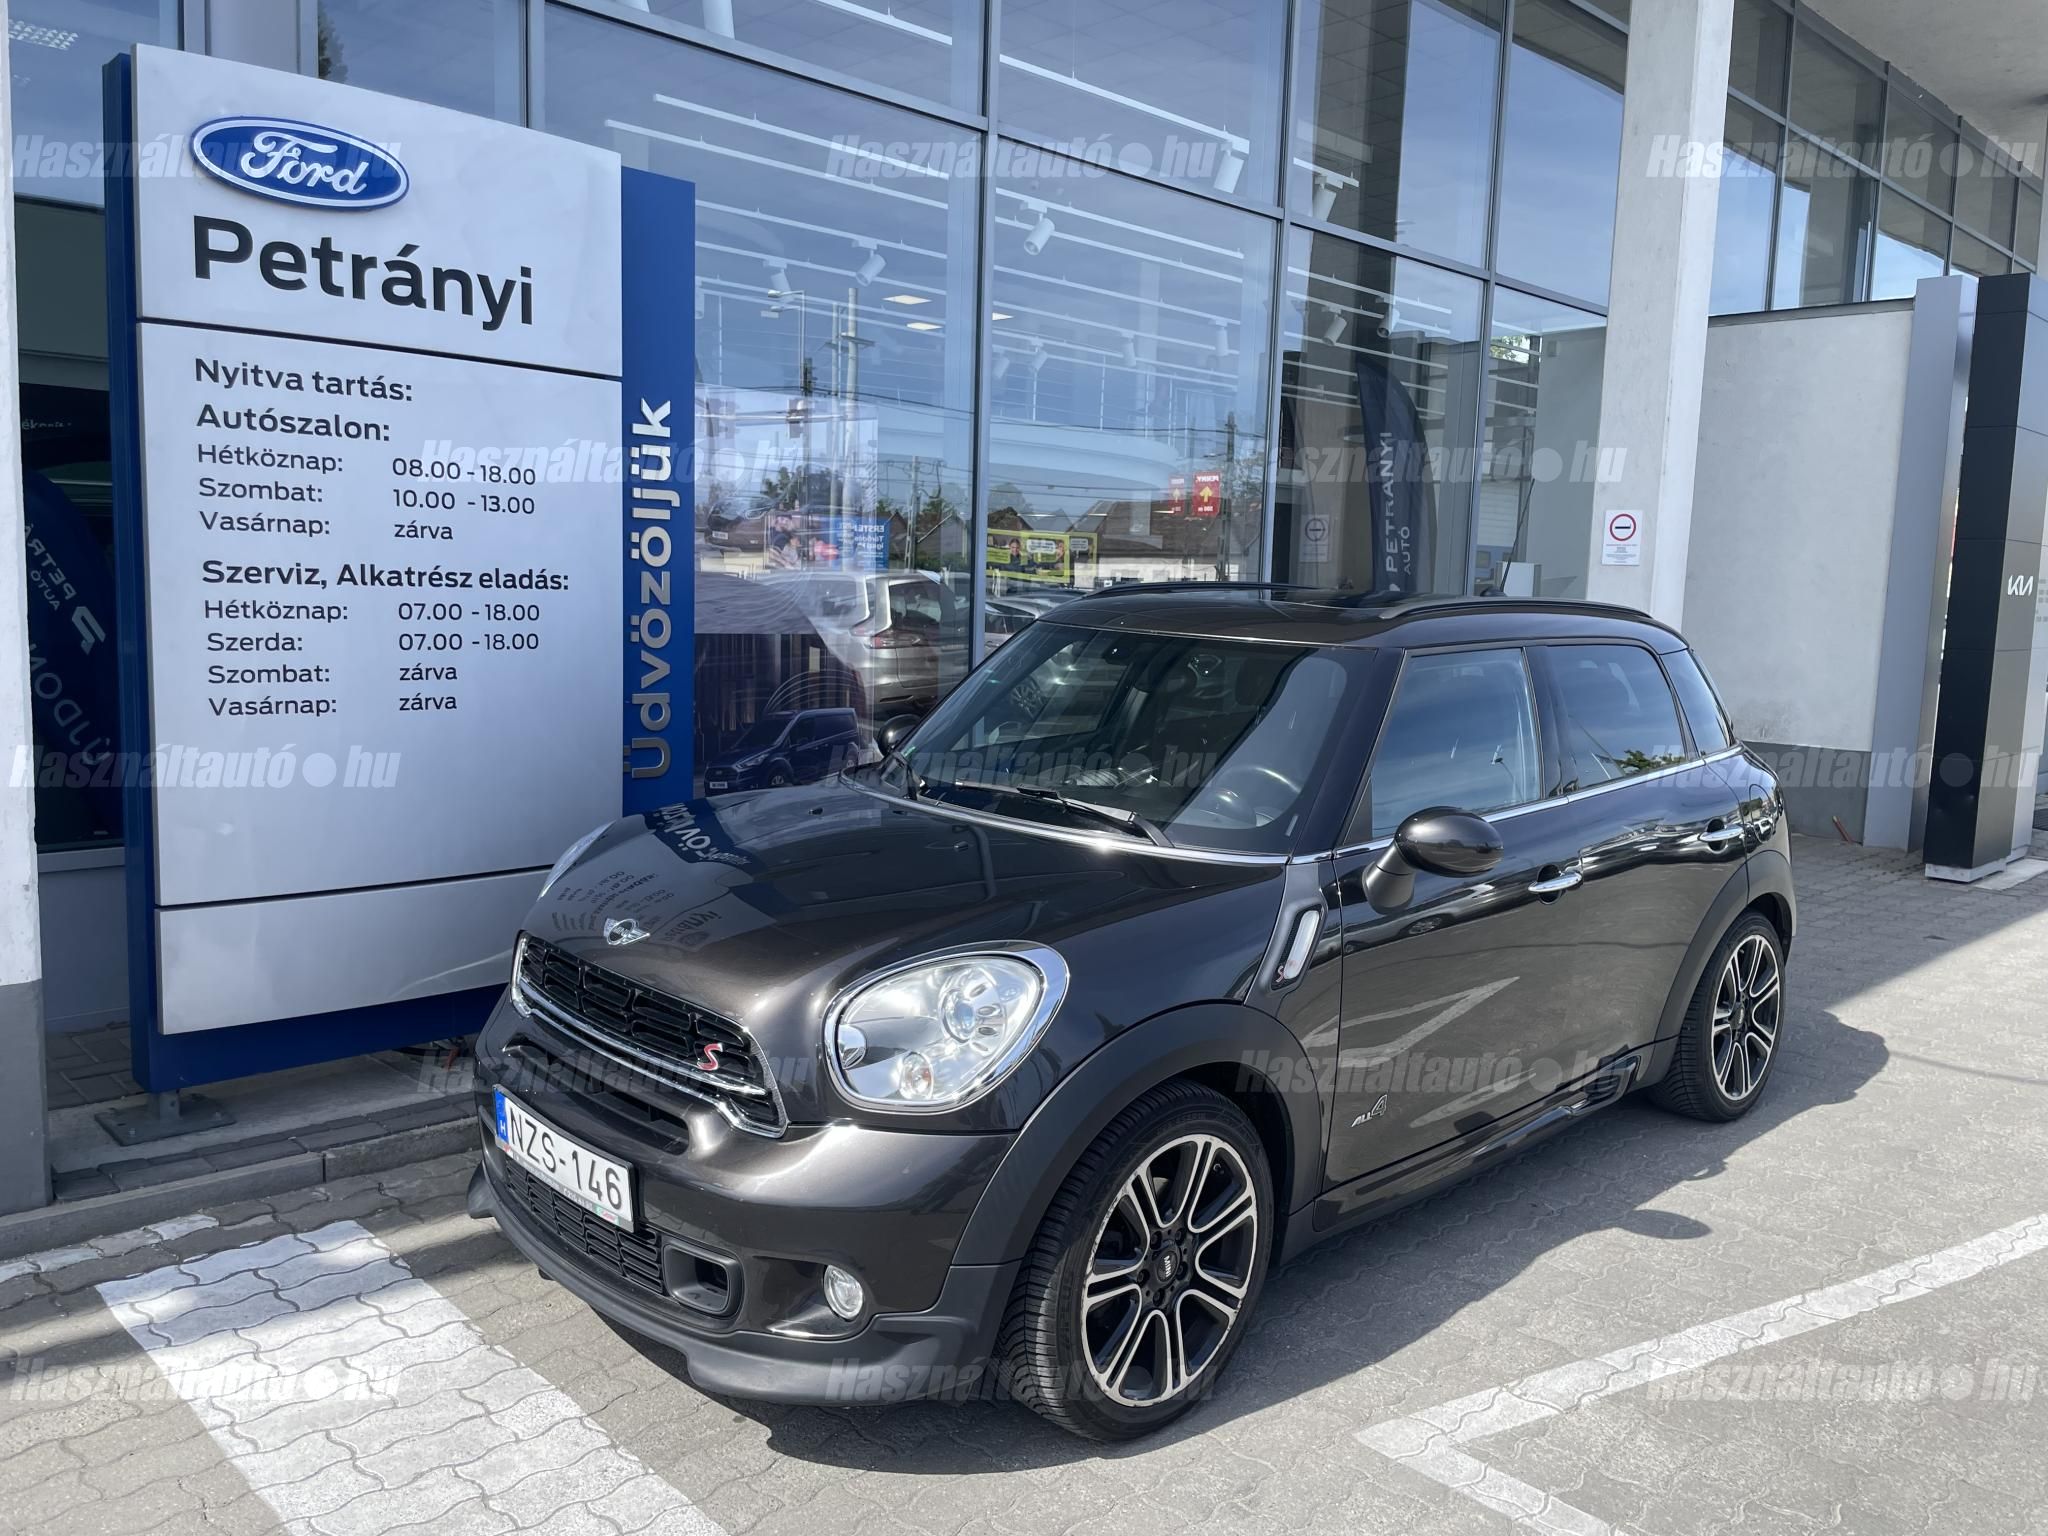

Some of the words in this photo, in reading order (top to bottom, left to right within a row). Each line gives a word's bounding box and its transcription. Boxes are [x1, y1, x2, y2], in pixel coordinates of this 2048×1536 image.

[240, 130, 370, 196] Ford
[192, 213, 534, 332] Petrányi
[195, 357, 304, 390] Nyitva
[312, 371, 413, 402] tartás:
[196, 403, 391, 442] Autószalon:
[198, 443, 343, 475] Hétköznap:
[392, 458, 461, 480] 08.00
[198, 477, 323, 502] Szombat:
[393, 489, 456, 509] 10.00
[480, 494, 535, 514] 13.00
[199, 510, 331, 538] Vasárnap:
[394, 520, 453, 540] zárva
[202, 560, 328, 590] Szerviz,
[336, 563, 474, 589] Alkatrész
[478, 567, 569, 590] eladás:
[623, 396, 680, 780] Üdvözöljük
[204, 599, 349, 623] Hétköznap:
[398, 602, 463, 621] 07.00
[484, 603, 540, 622] 18.00
[207, 632, 303, 652] Szerda:
[398, 632, 463, 651] 07.00
[484, 633, 539, 651] 18.00
[208, 663, 330, 684] Szombat:
[399, 663, 458, 681] zárva
[208, 695, 337, 717] Vasárnap:
[399, 693, 458, 711] zárva
[510, 1107, 623, 1211] NZS-146
